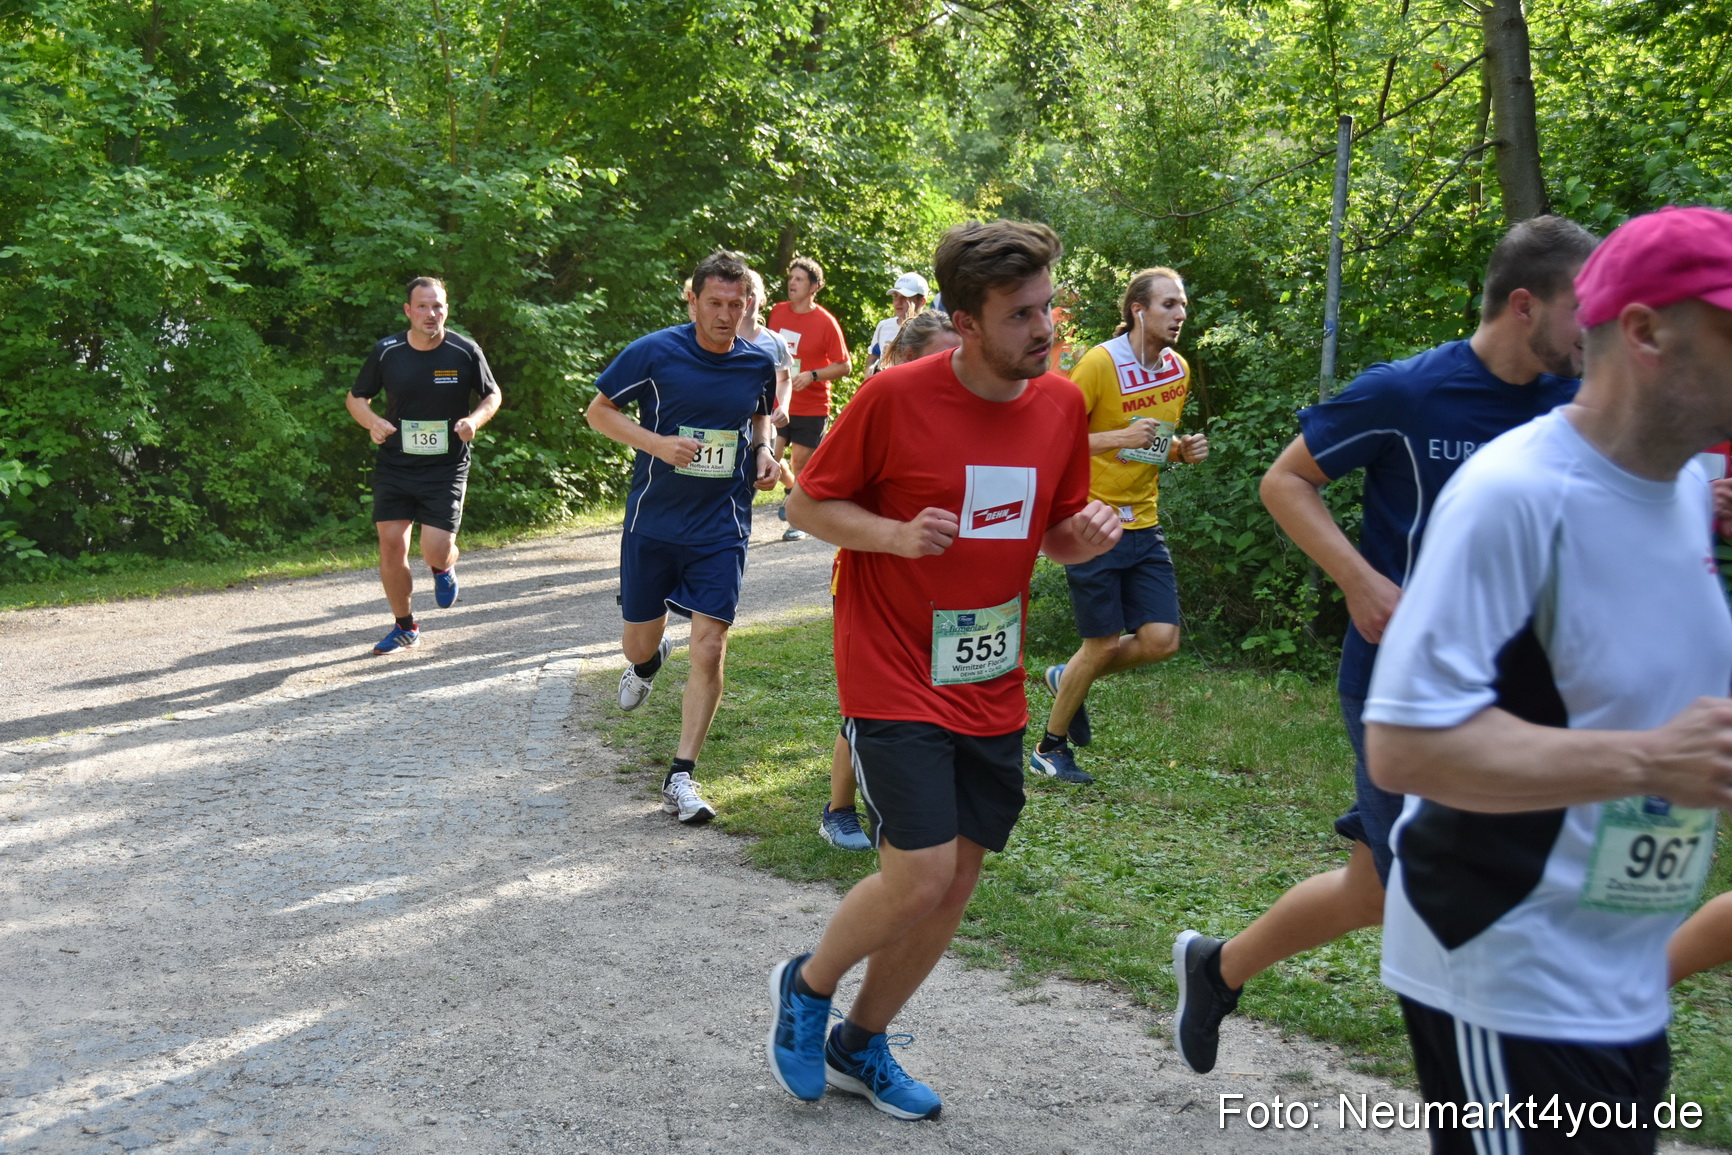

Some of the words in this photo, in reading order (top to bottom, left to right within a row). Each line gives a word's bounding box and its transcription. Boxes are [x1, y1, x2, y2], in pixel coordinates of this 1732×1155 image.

[1122, 394, 1157, 413] MAX
[412, 433, 437, 446] 136
[1143, 437, 1168, 453] 90
[1428, 438, 1487, 461] EUR
[985, 508, 1009, 521] DEHN
[956, 631, 1006, 663] 553
[953, 664, 986, 672] Wirnitzer
[987, 656, 1008, 667] Florian
[1625, 834, 1700, 880] 967
